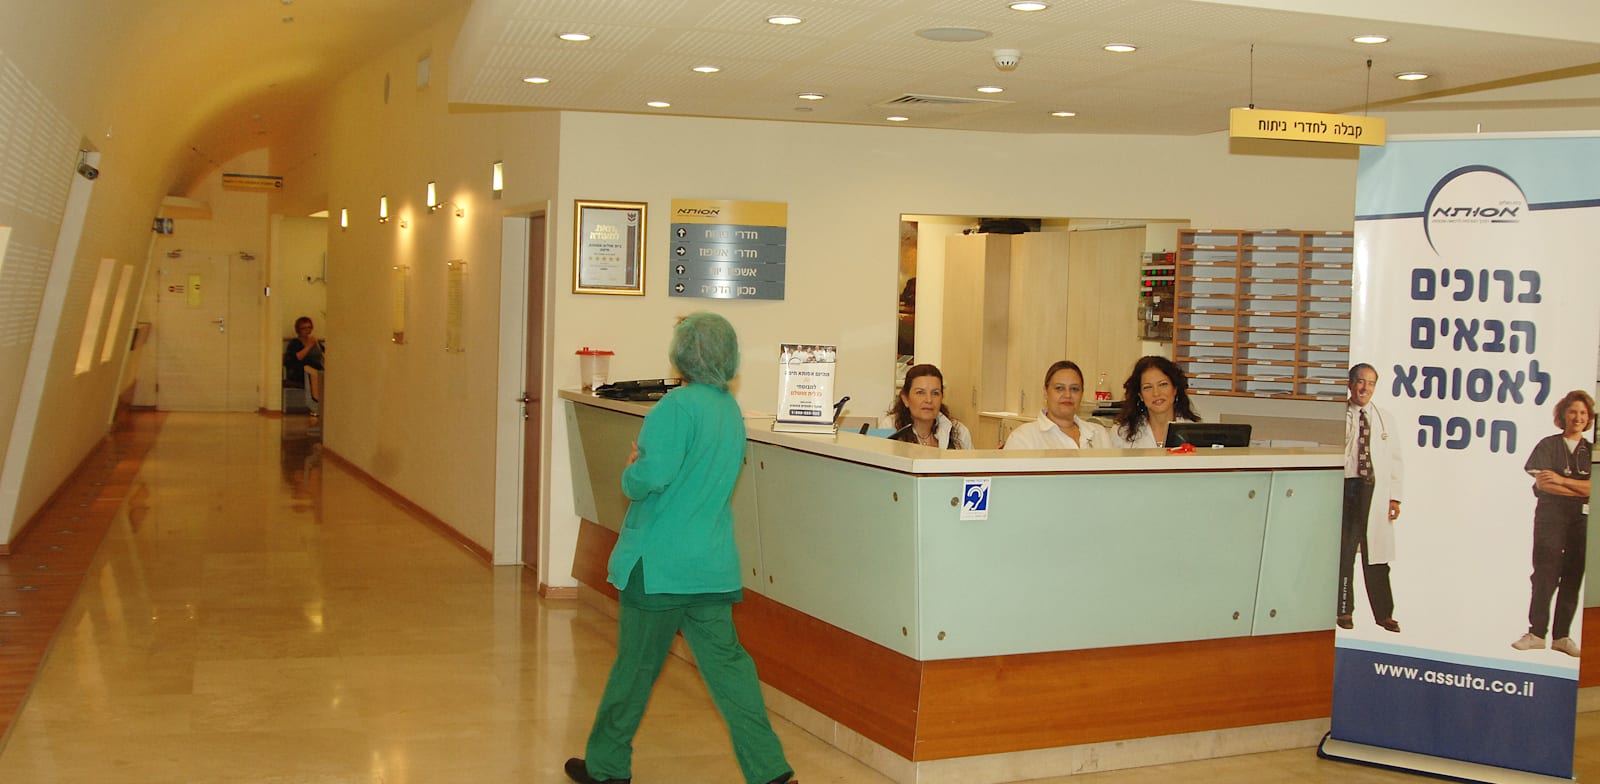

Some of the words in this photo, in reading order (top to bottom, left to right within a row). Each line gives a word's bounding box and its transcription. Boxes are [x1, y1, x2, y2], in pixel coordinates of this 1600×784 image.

[1258, 119, 1287, 131] ניתוח
[1294, 120, 1327, 134] לחדרי
[1334, 122, 1363, 139] קבלה
[1432, 206, 1520, 218] אסותא
[735, 230, 758, 240] חדרי
[734, 248, 758, 259] חדרי
[737, 286, 757, 297] מכון
[1411, 268, 1542, 304] ברוכים
[1410, 317, 1537, 355] הבאים
[1392, 359, 1552, 406] לאסותא
[1417, 415, 1517, 454] חיפה
[1374, 662, 1535, 698] www.assuta.co.il
